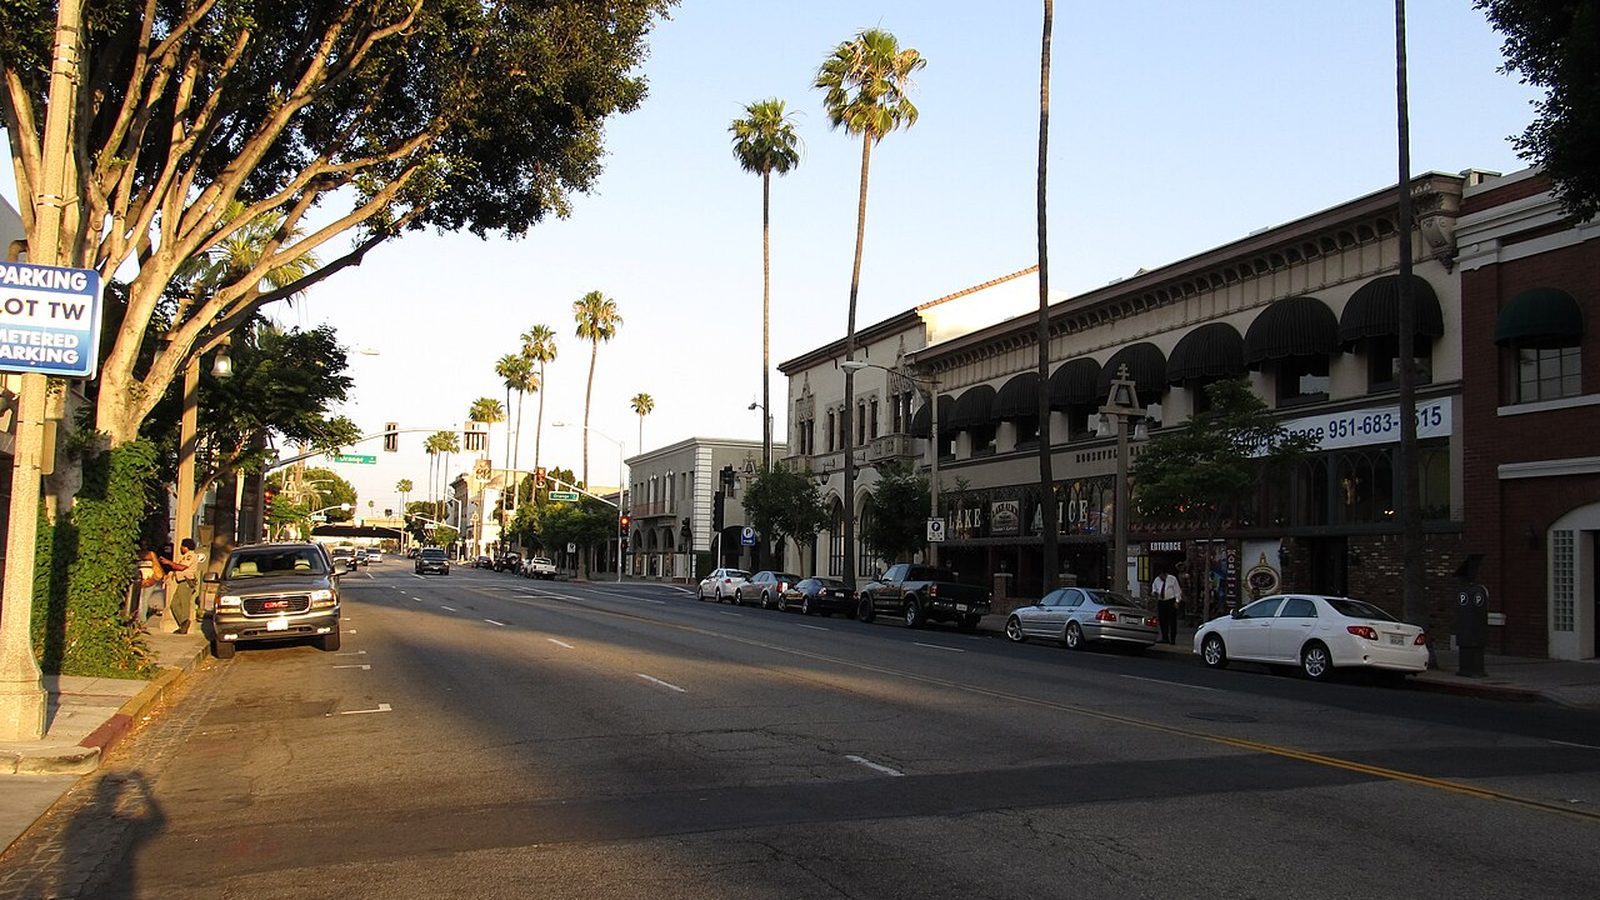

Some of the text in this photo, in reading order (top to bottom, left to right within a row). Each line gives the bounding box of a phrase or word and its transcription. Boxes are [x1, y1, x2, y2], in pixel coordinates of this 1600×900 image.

[0, 298, 86, 320] OT TW
[0, 344, 79, 364] ARKING
[1076, 448, 1118, 463] ROOSEVEL
[948, 508, 981, 530] LAKE
[1030, 499, 1088, 529] AICE
[1150, 542, 1182, 551] ENTRANCE
[264, 600, 289, 609] GMC
